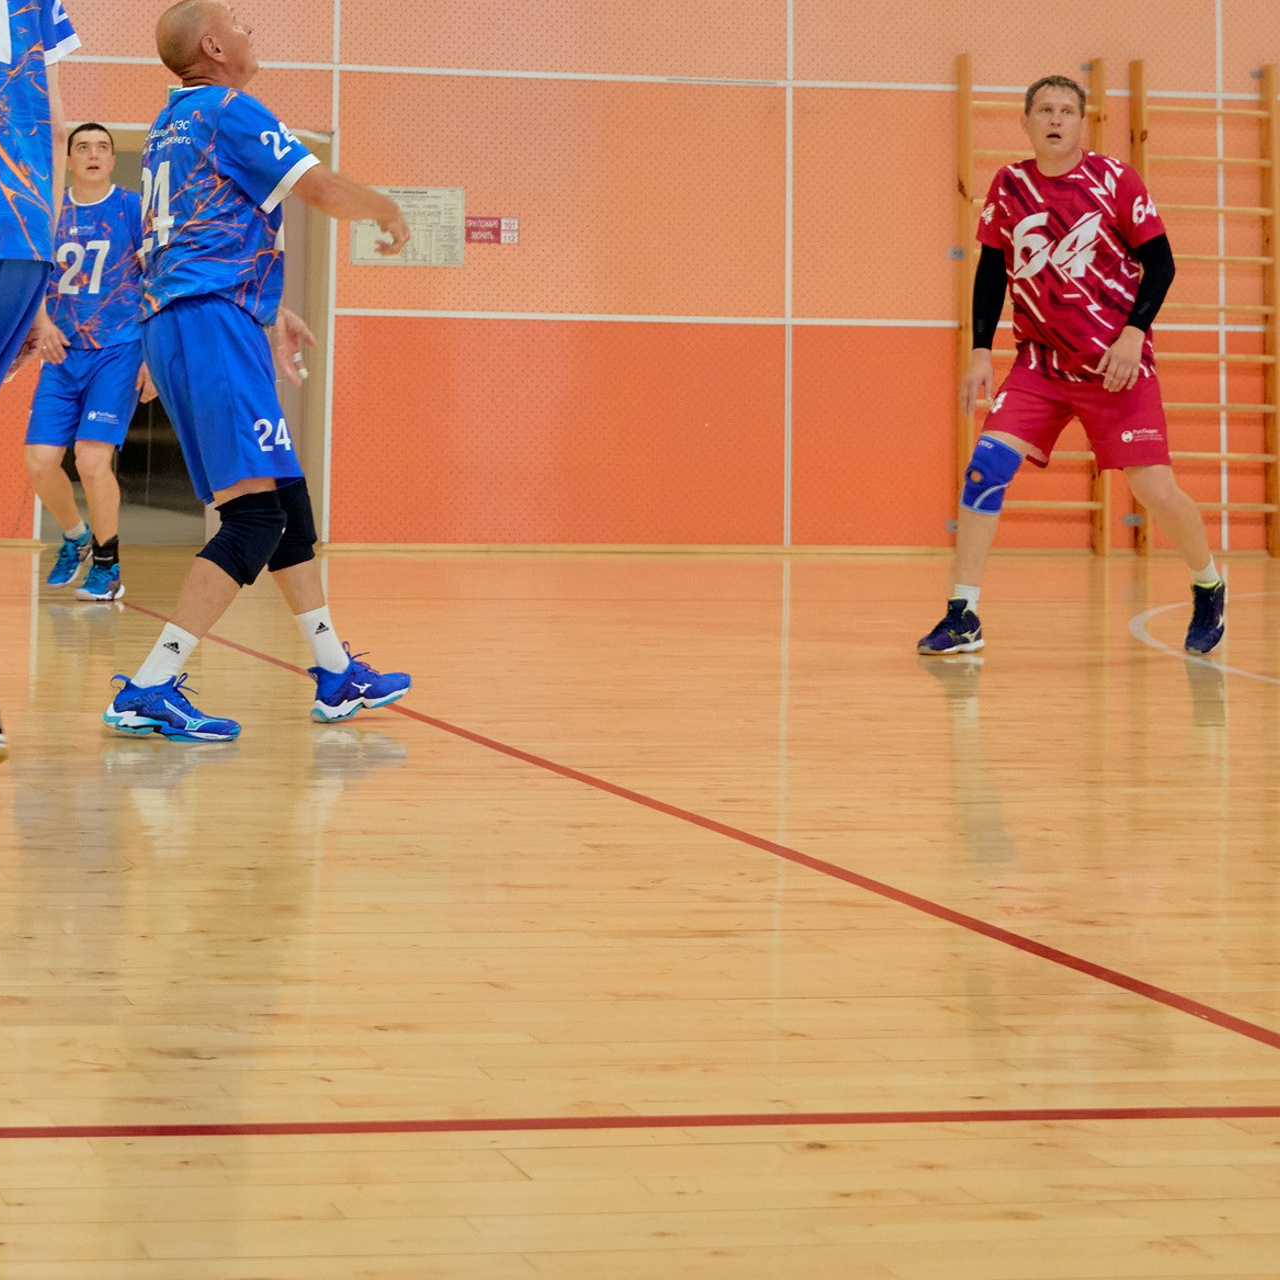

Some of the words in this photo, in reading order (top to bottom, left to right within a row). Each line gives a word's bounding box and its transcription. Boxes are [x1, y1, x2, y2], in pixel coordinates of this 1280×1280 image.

[260, 121, 302, 160] 24
[1132, 193, 1158, 227] 64
[1013, 209, 1104, 280] 64
[56, 240, 110, 295] 27
[253, 417, 292, 452] 24
